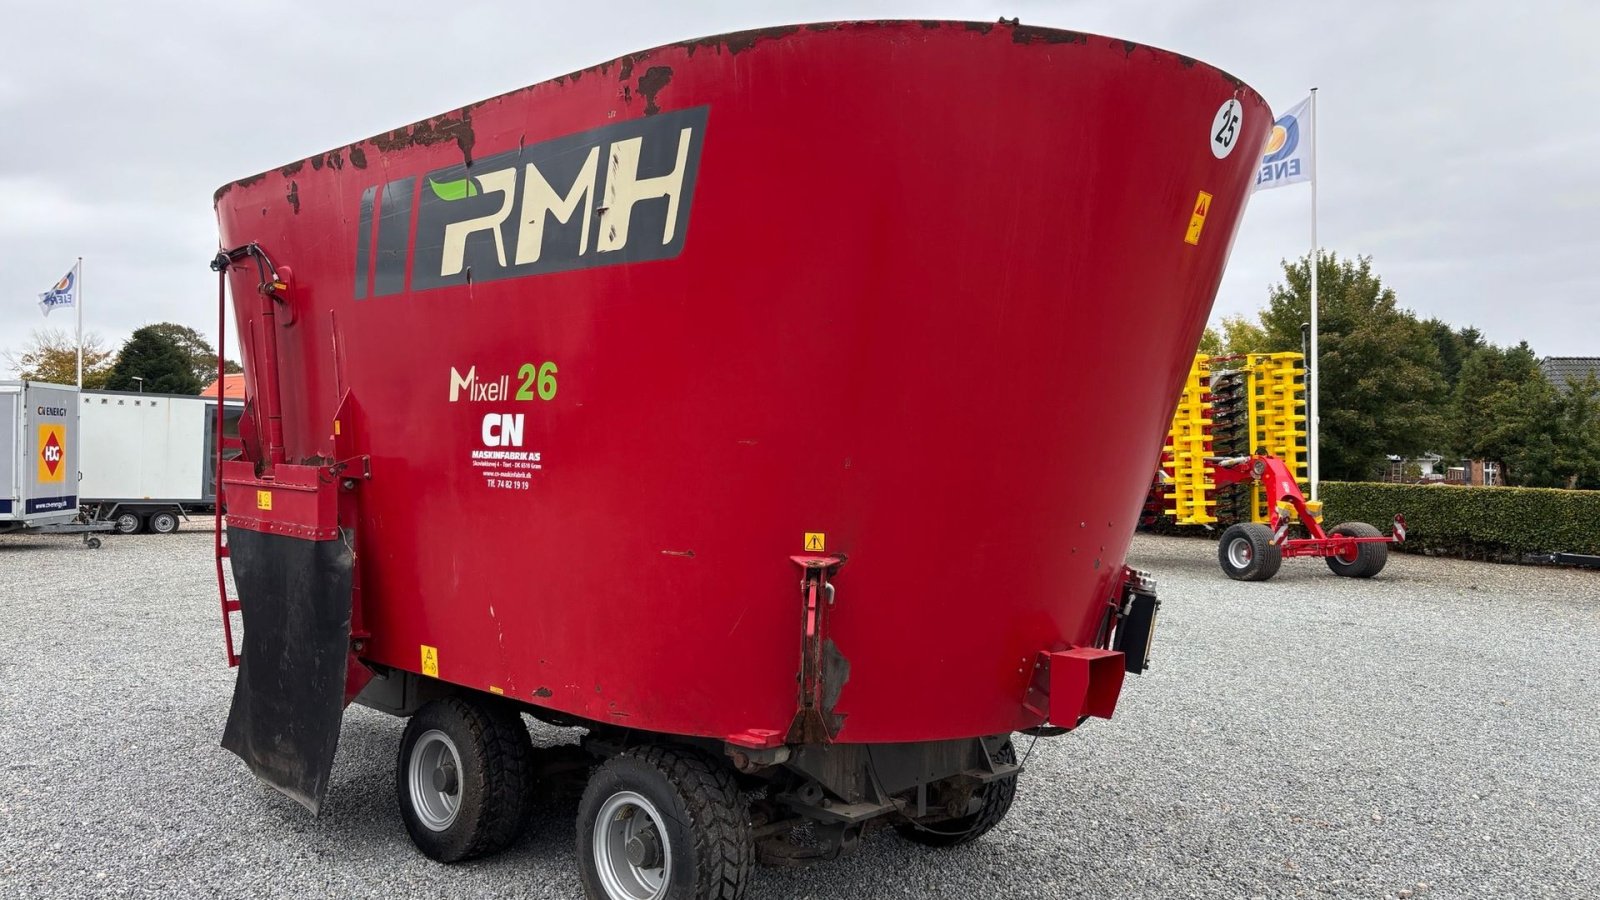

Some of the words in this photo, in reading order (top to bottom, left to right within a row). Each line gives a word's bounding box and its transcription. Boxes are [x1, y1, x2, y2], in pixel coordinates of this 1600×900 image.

[1214, 109, 1239, 148] 25
[437, 127, 693, 277] RMH
[449, 365, 509, 402] Mixell
[515, 361, 558, 401] 26
[46, 406, 67, 417] ENERGY
[482, 413, 525, 447] CN
[45, 445, 60, 461] HDG
[471, 450, 528, 461] MASKINFABRIK
[497, 479, 504, 488] 74
[505, 480, 513, 489] 82
[513, 480, 521, 489] 19
[521, 481, 529, 490] 19
